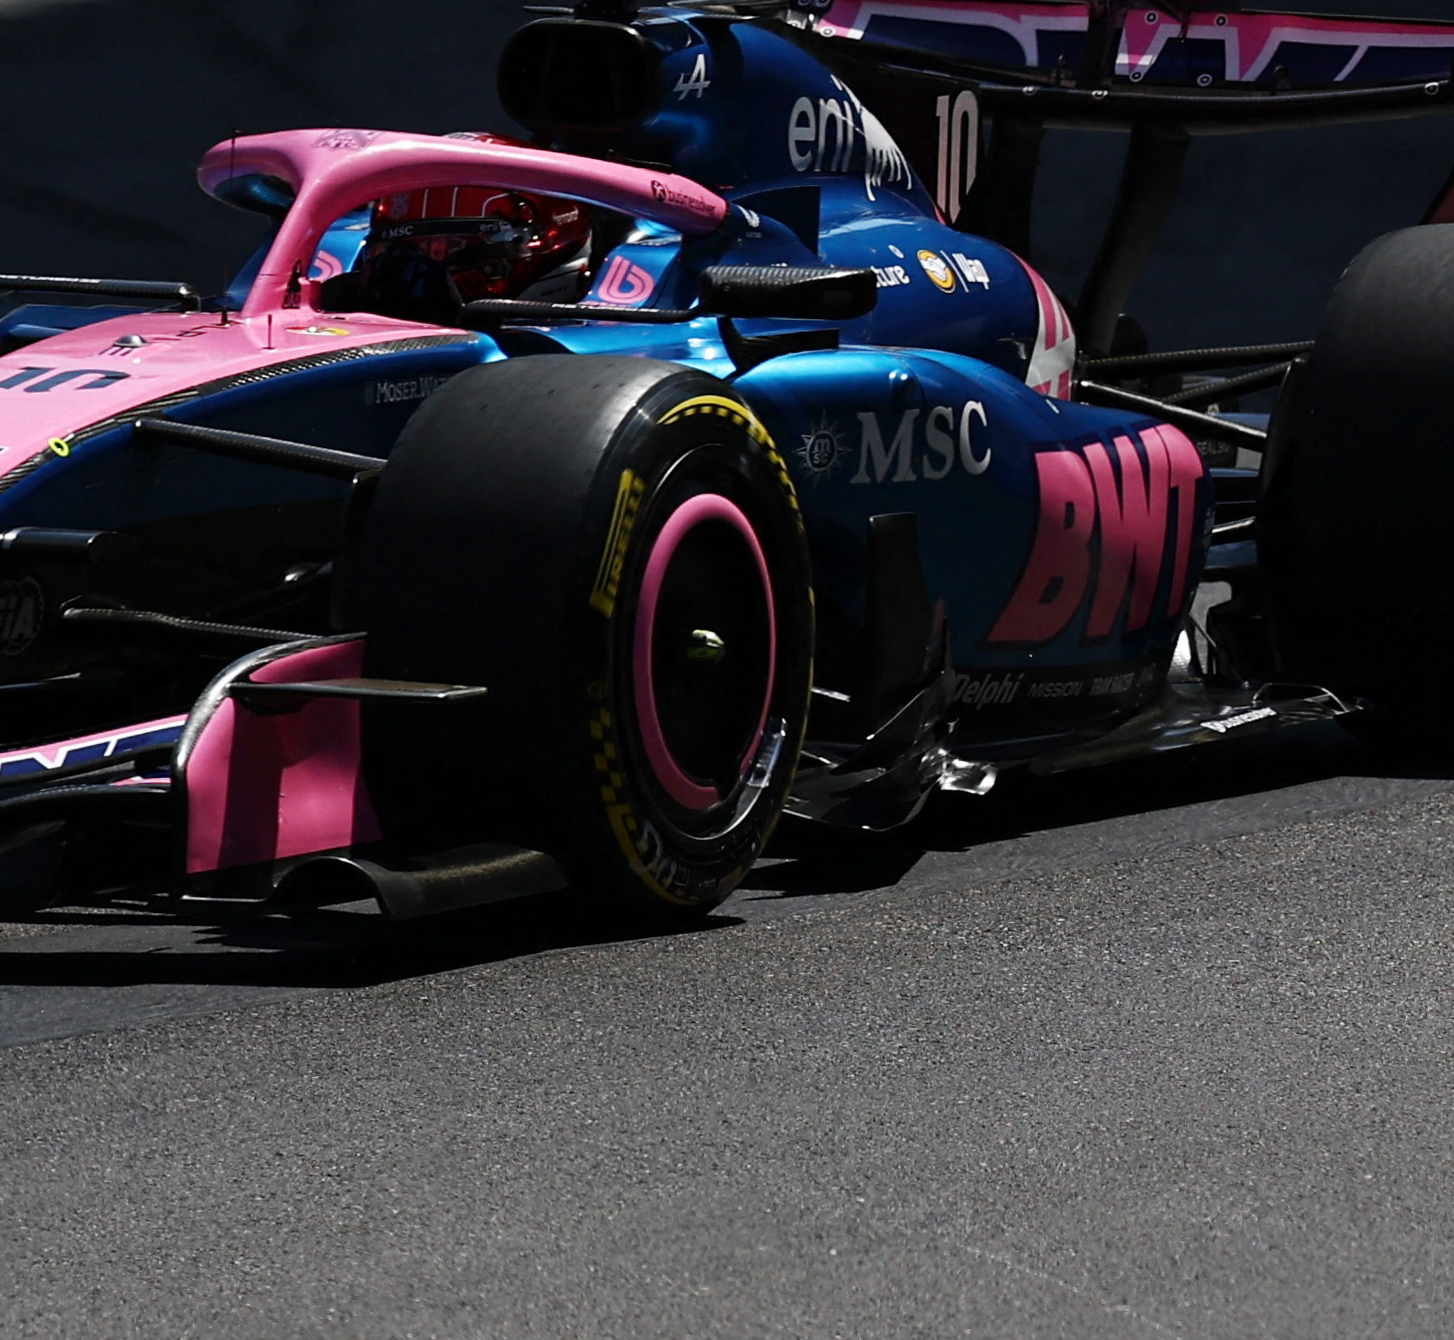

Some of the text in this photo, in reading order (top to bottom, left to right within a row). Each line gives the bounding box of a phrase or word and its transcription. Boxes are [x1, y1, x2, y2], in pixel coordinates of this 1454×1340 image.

[786, 74, 856, 174] eni
[935, 89, 980, 224] 10
[387, 225, 414, 239] MSC
[849, 399, 992, 484] MSC
[986, 421, 1204, 644] BWT
[951, 672, 1025, 710] Delphi
[1026, 680, 1084, 699] MISSION
